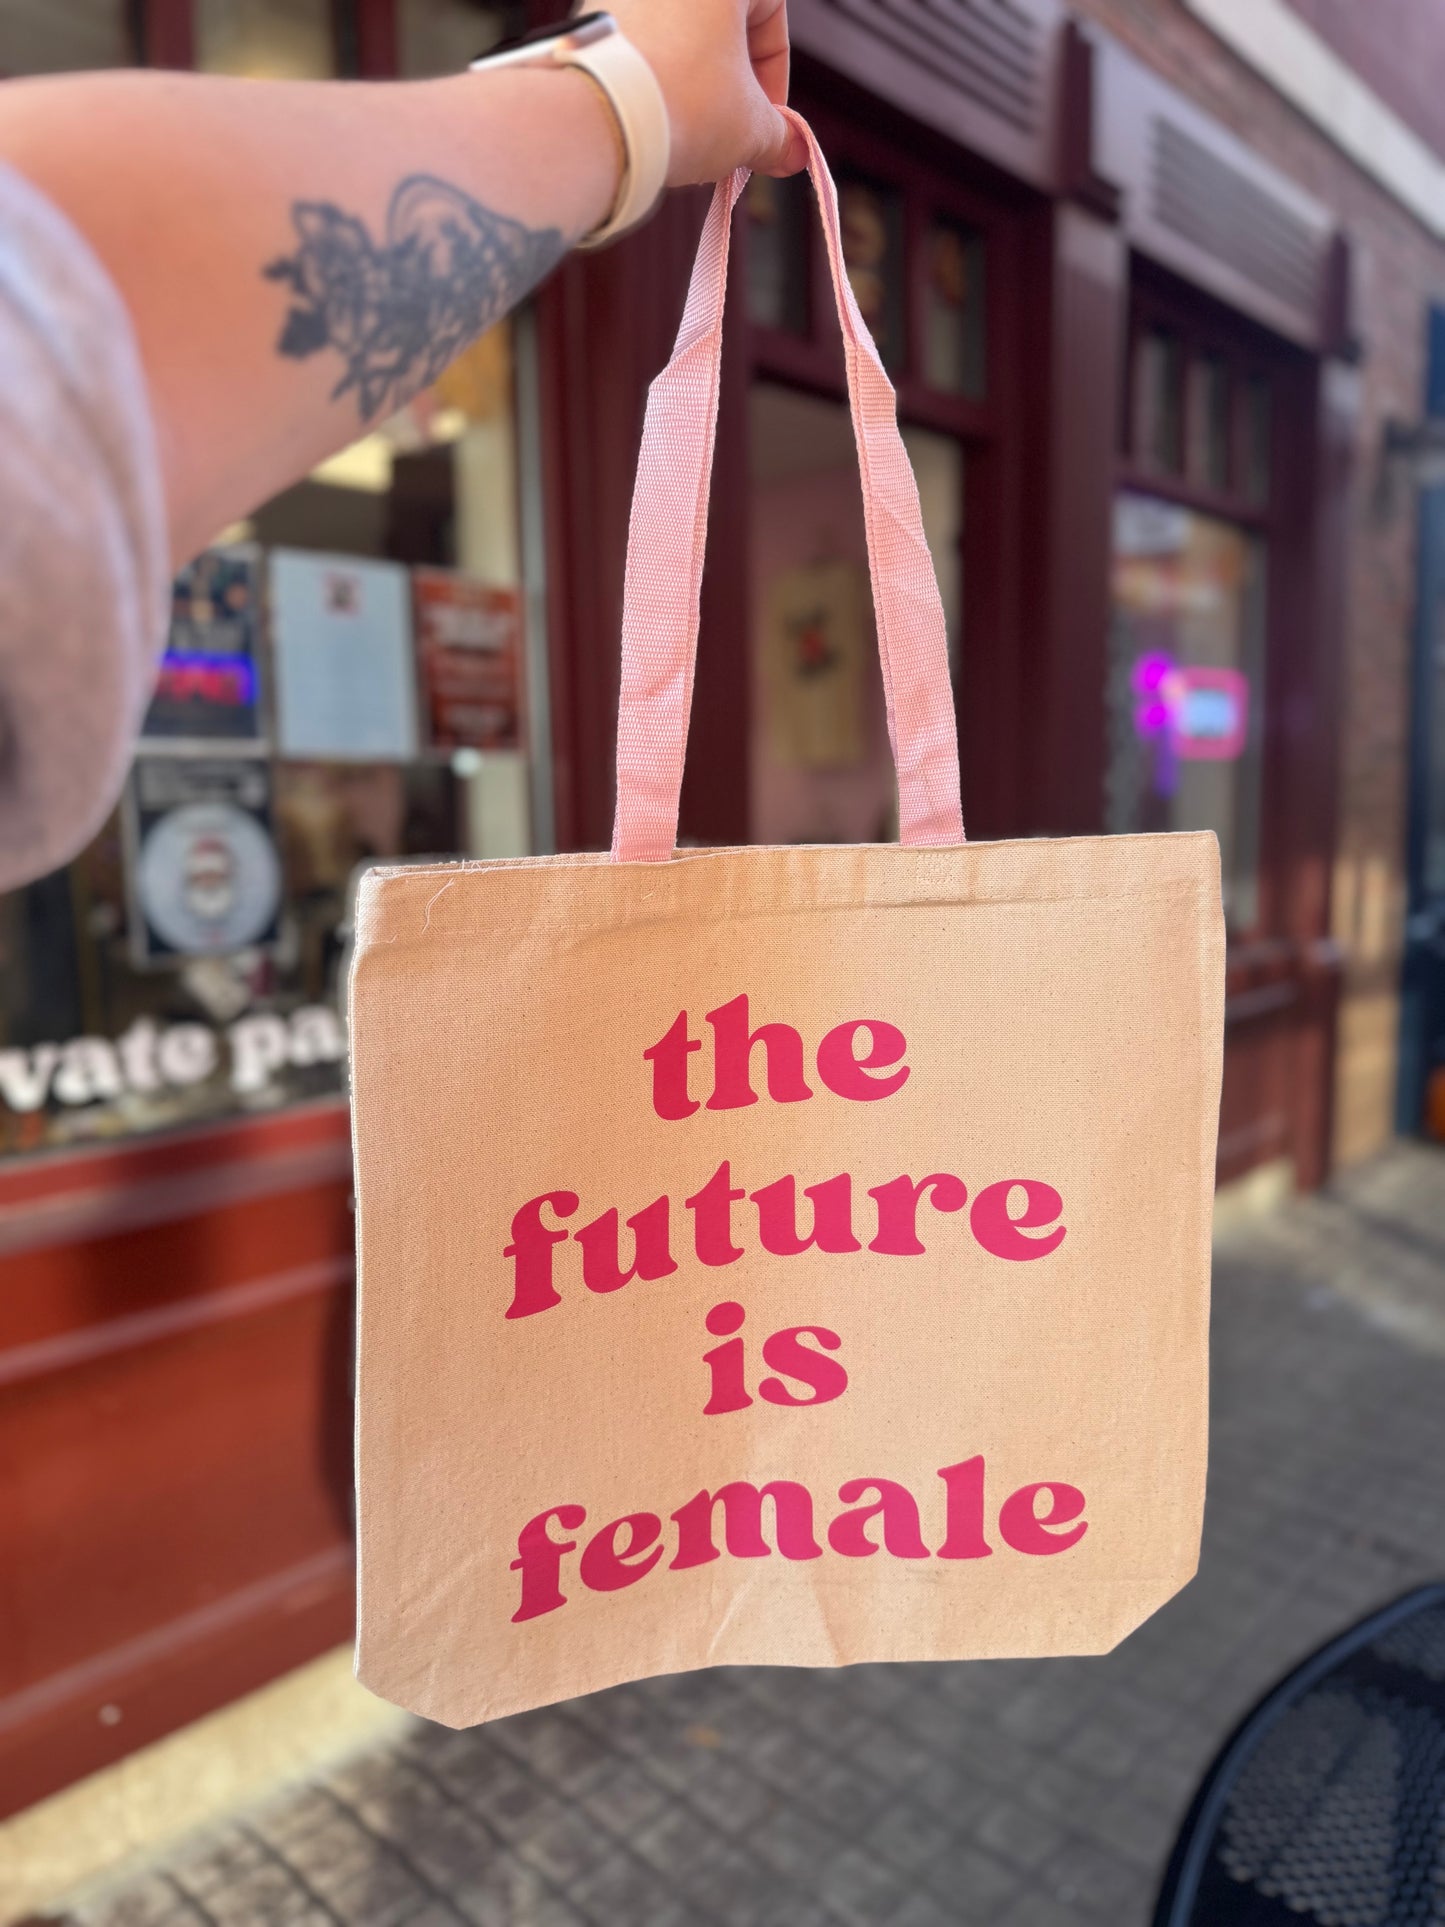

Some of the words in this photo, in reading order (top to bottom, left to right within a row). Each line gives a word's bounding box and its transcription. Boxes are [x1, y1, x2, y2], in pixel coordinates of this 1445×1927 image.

[643, 994, 910, 1121] the
[503, 1161, 1067, 1319] future
[703, 1302, 848, 1416] is
[510, 1456, 1088, 1623] female
